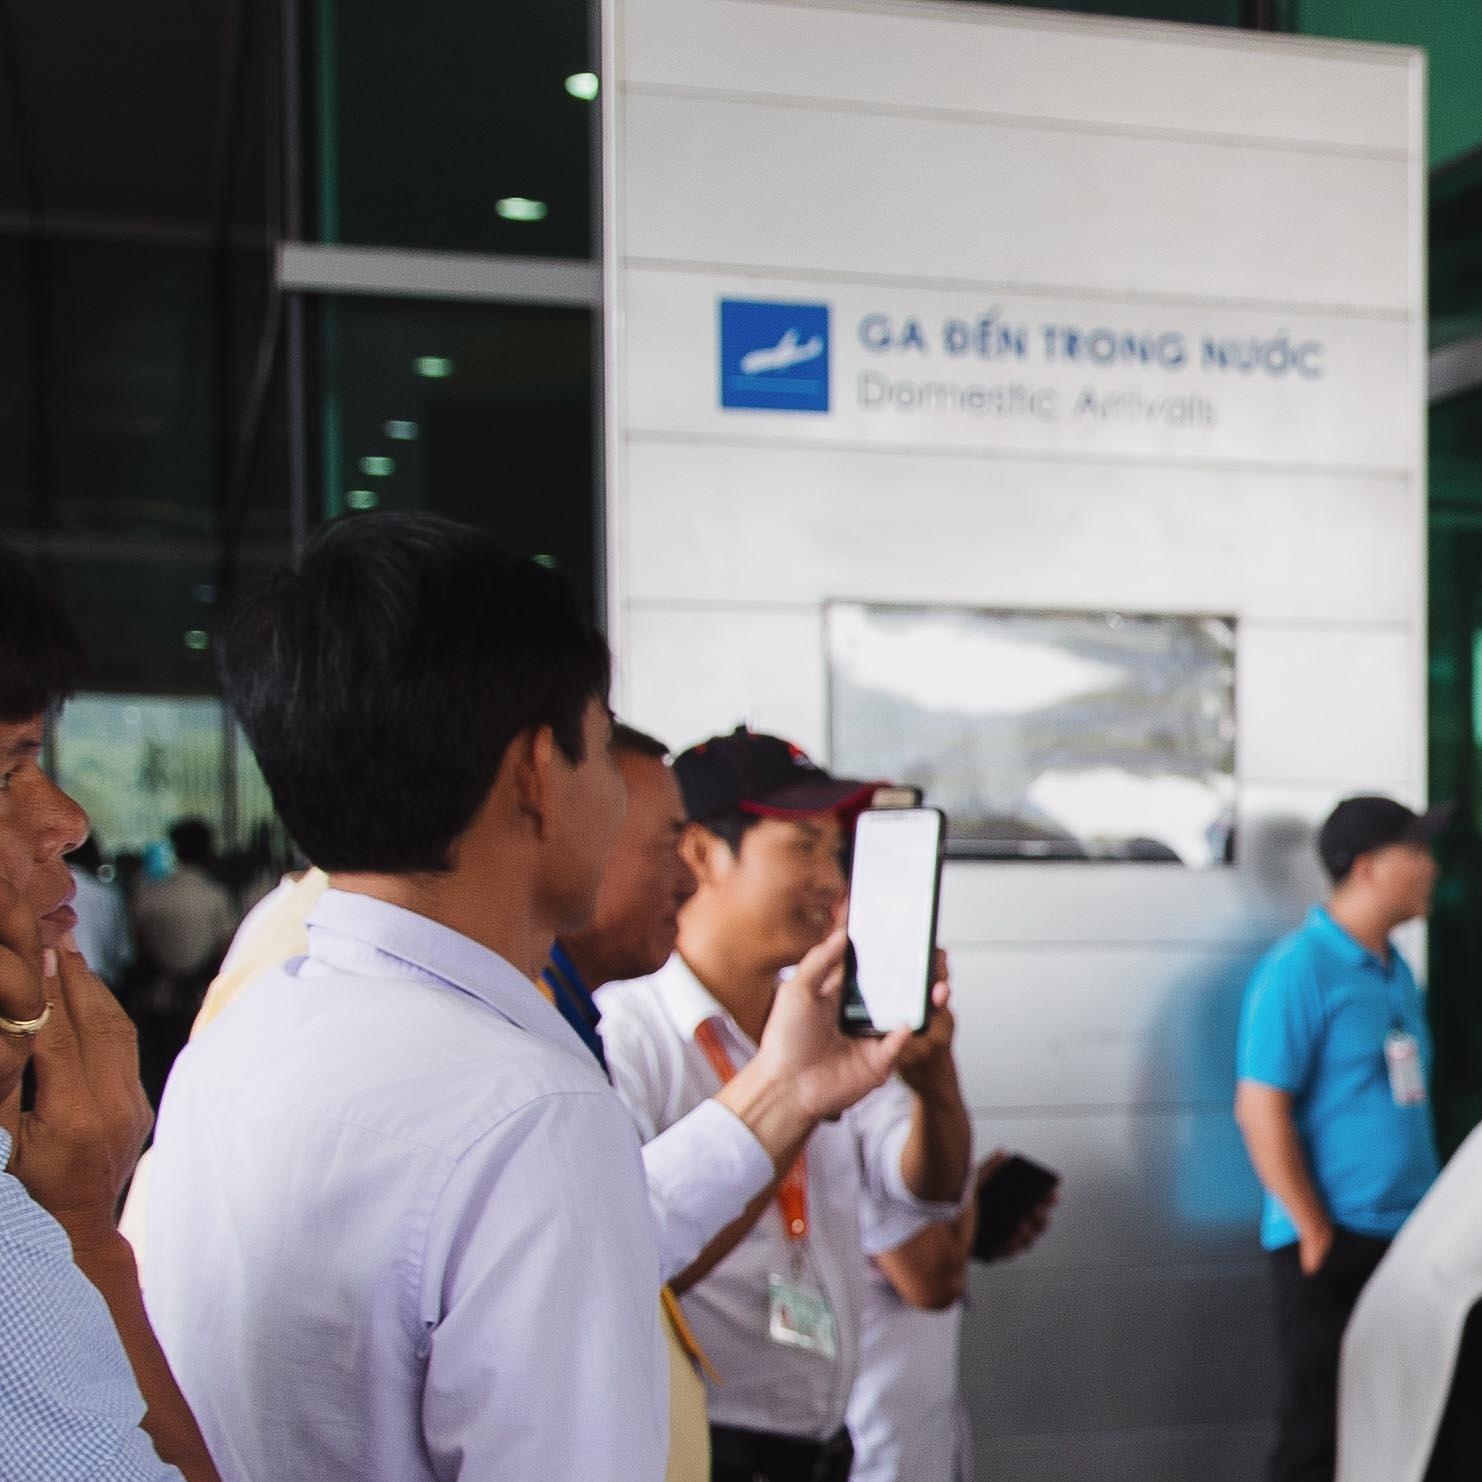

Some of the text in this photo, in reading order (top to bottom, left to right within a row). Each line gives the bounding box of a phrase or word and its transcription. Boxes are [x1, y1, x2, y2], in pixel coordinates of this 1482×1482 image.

[857, 313, 926, 354] GA
[942, 305, 1029, 361] ĐẾN
[1041, 322, 1188, 370] TRONG
[856, 369, 1220, 428] Domestic Arrivals
